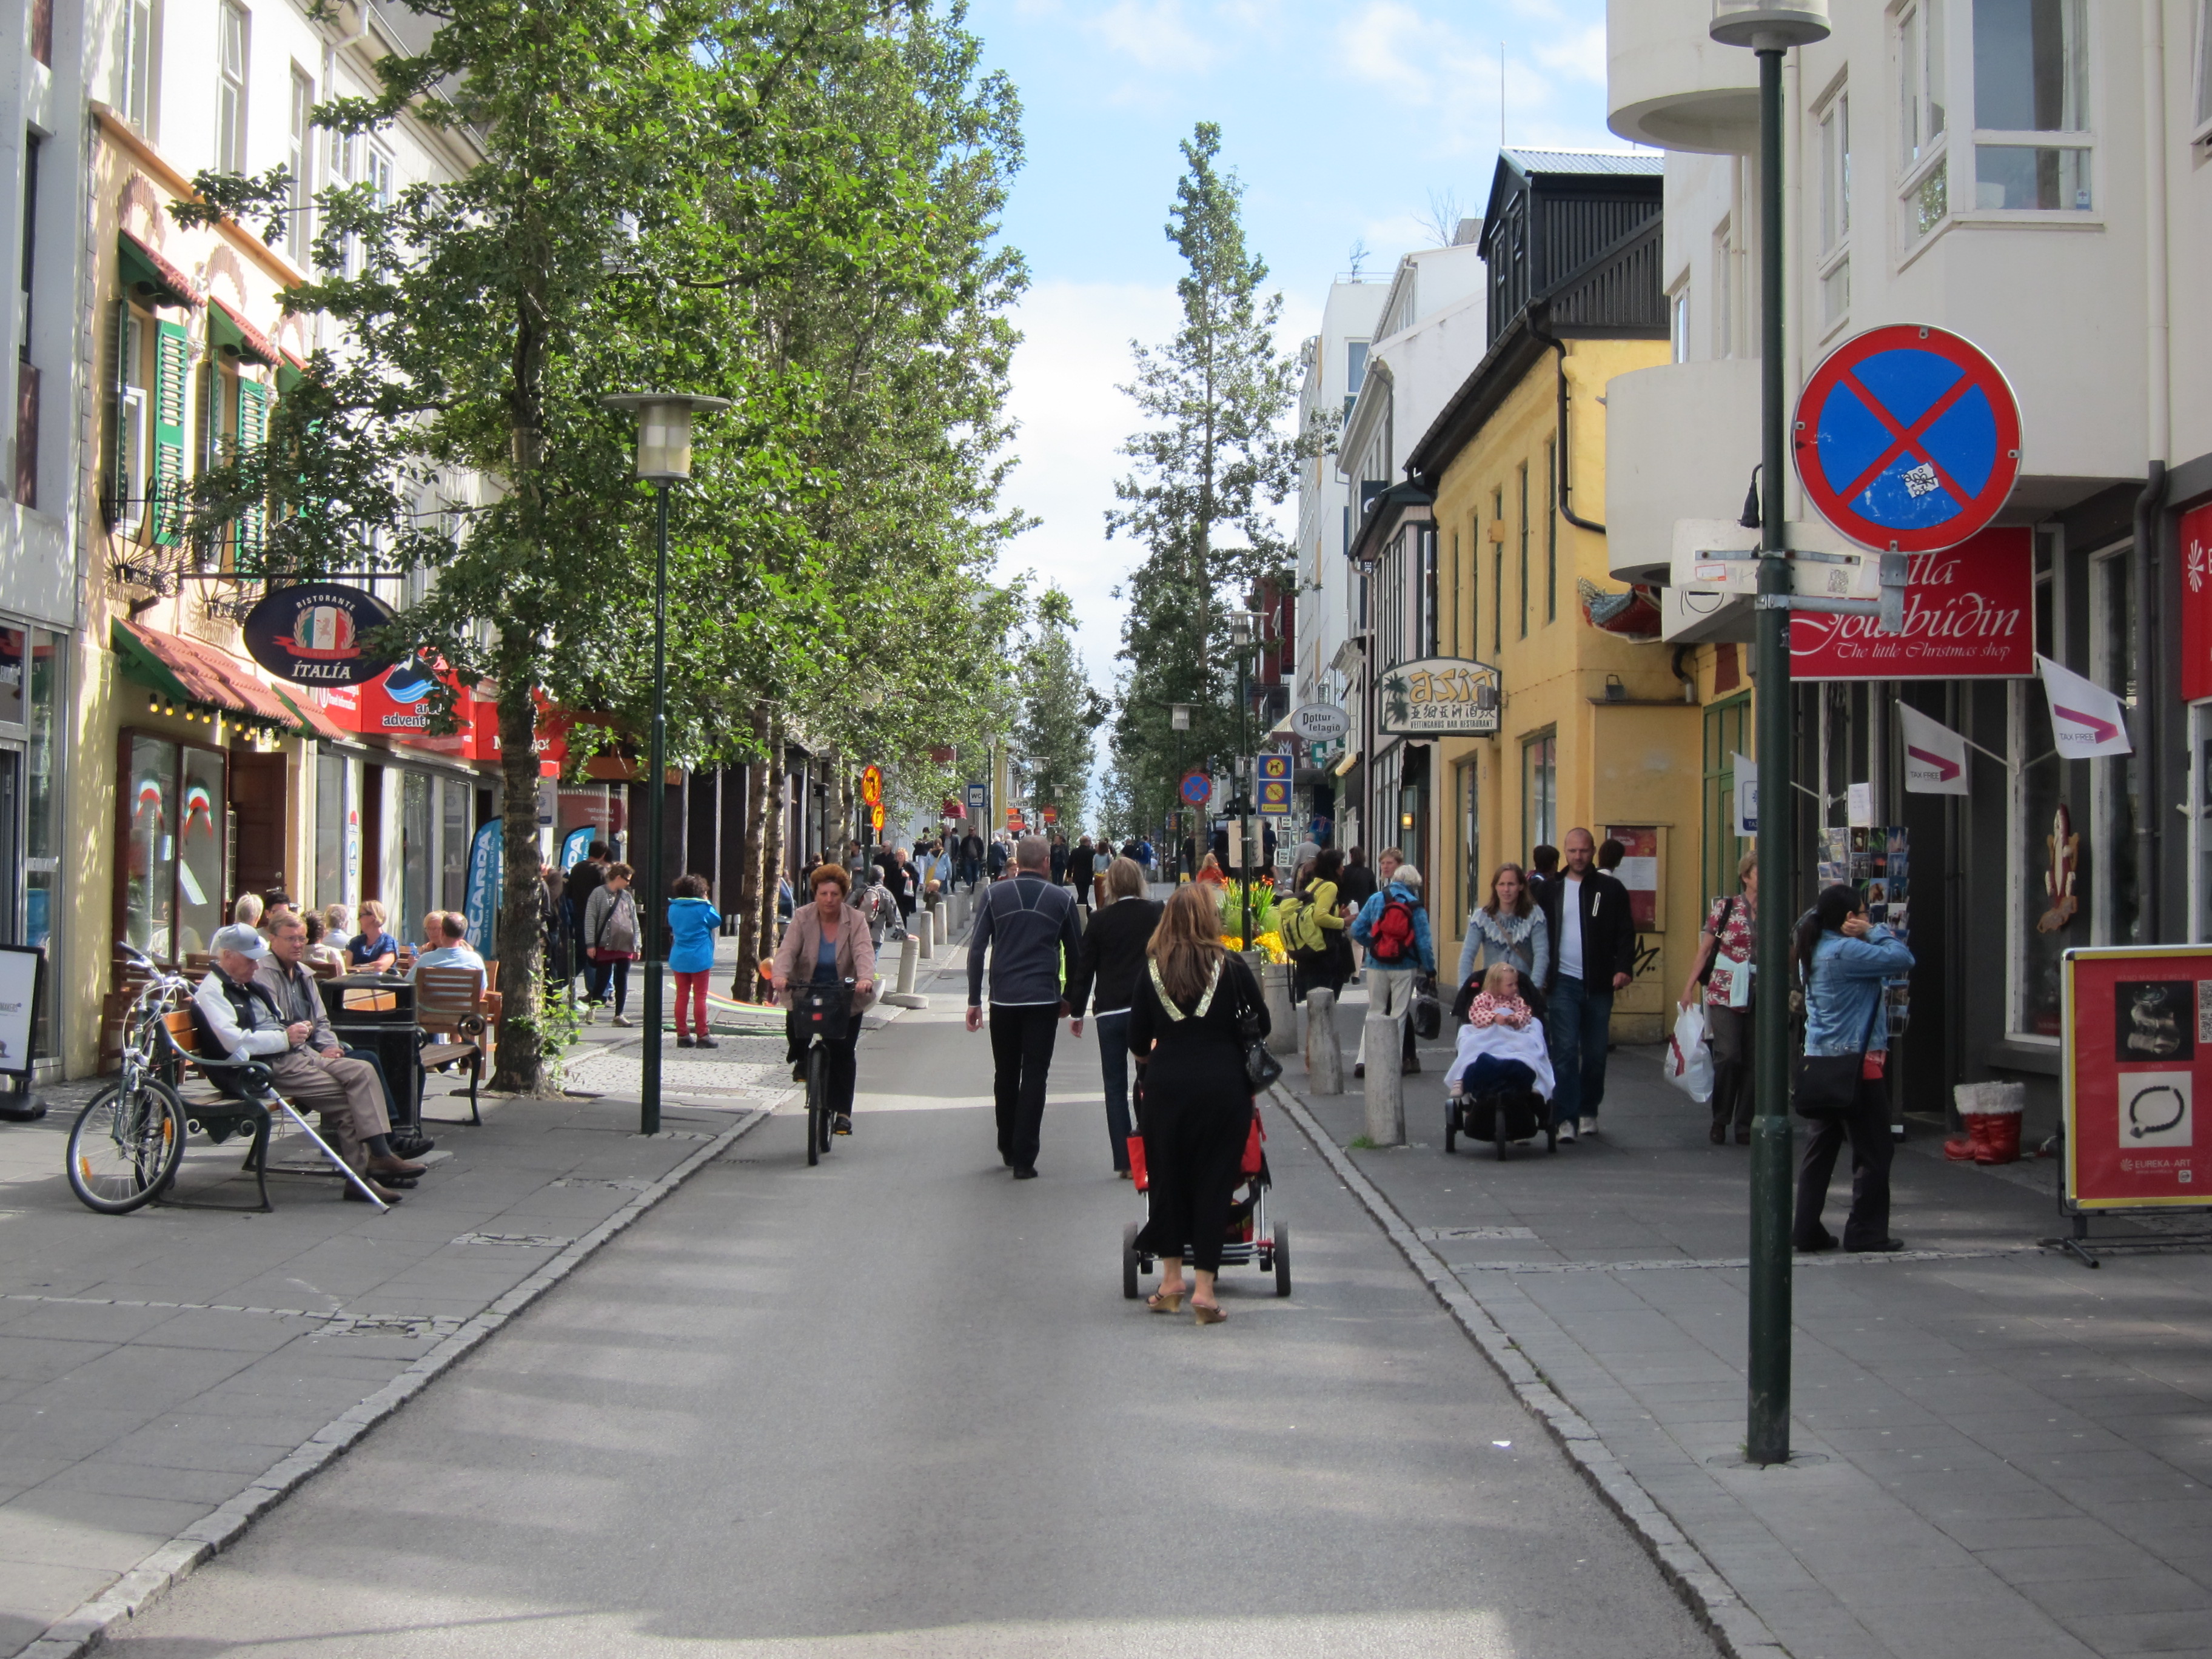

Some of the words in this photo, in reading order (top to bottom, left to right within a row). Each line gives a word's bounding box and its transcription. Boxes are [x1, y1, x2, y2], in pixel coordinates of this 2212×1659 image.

[296, 595, 356, 611] RISTORANTE
[1834, 642, 1867, 659] The
[1872, 643, 1901, 659] little
[1906, 642, 1977, 659] Christmas
[1980, 642, 2011, 662] shop
[292, 660, 351, 679] ÍTALÍA
[1409, 668, 1495, 703] asia
[1447, 720, 1458, 728] BAR
[1460, 719, 1493, 728] RESTAURANT
[2060, 732, 2074, 741] TAX
[1911, 771, 1923, 779] TAX
[468, 830, 492, 947] SCARPA
[2135, 1159, 2191, 1168] EUREKA-ART
